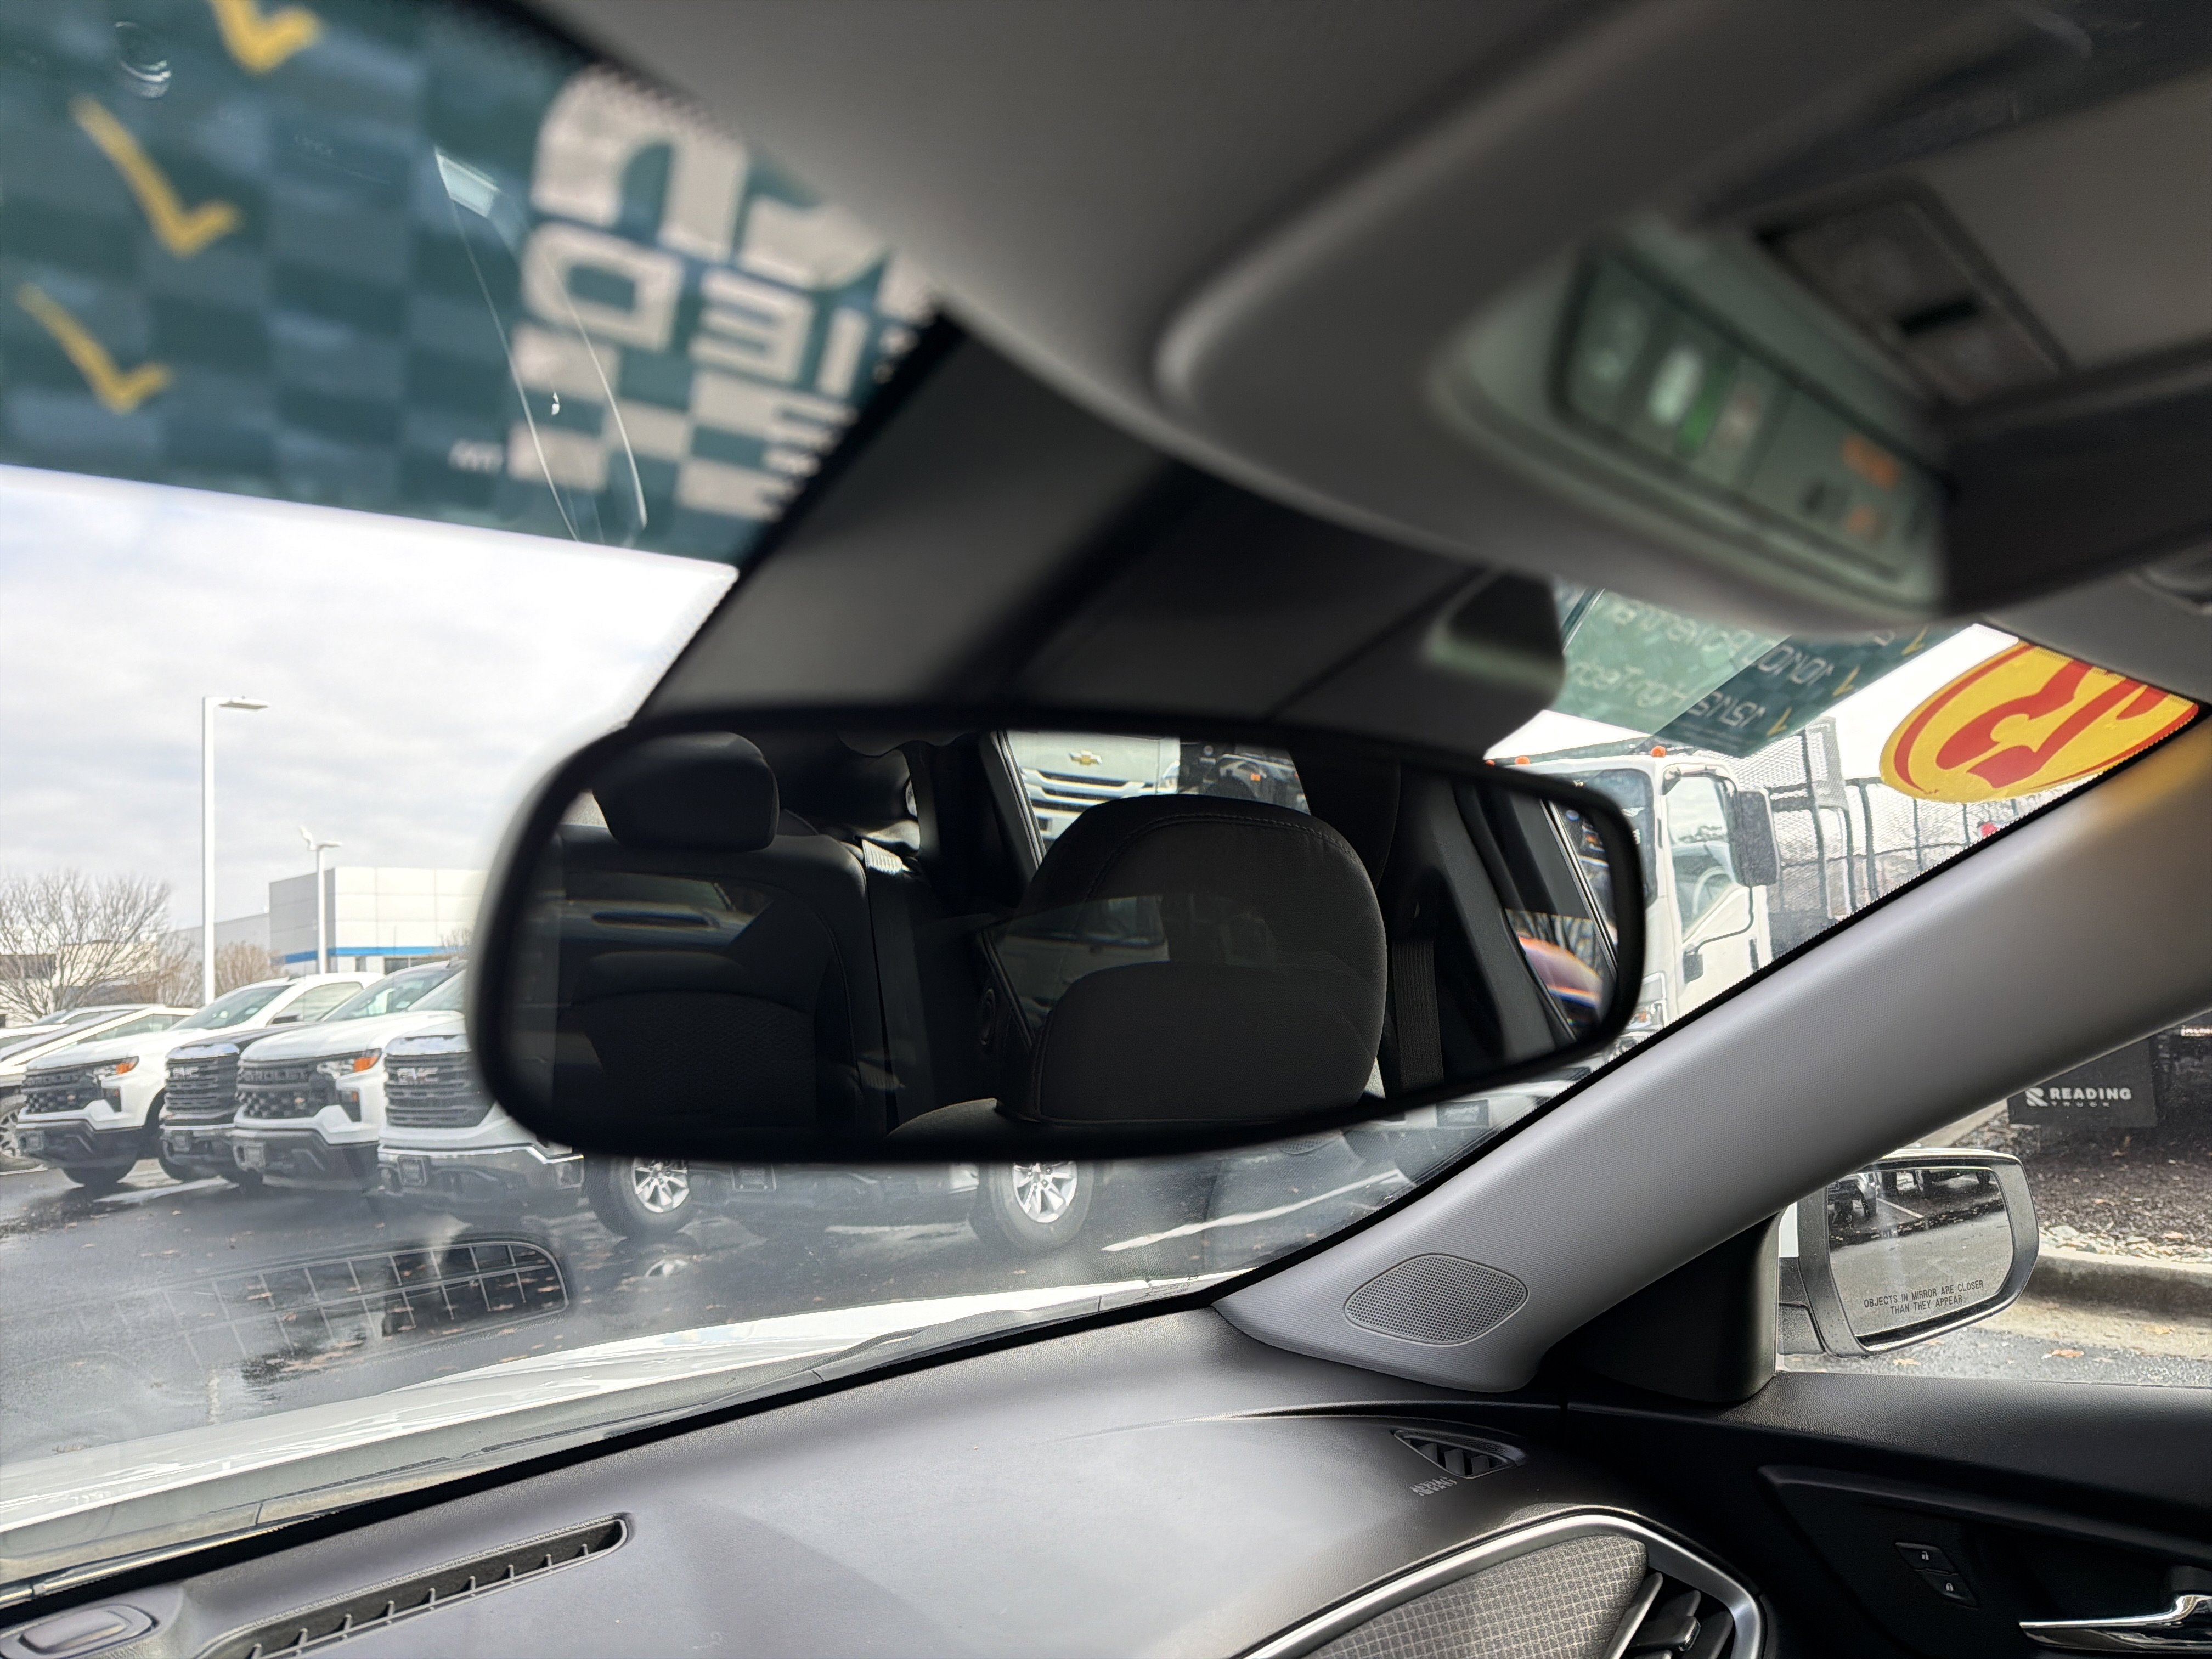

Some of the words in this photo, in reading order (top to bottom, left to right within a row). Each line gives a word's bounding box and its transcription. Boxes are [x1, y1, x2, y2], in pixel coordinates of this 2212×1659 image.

[2050, 1087, 2132, 1100] READING
[1864, 1295, 1898, 1308] OBJECTS
[1901, 1293, 1908, 1302] IN
[1911, 1288, 1937, 1300] MIRROR
[1941, 1285, 1954, 1295] ARE
[1957, 1280, 1984, 1292] CLOSER
[1890, 1304, 1910, 1314] THAN
[1913, 1299, 1931, 1311] THEY
[1936, 1295, 1963, 1307] APPEAR
